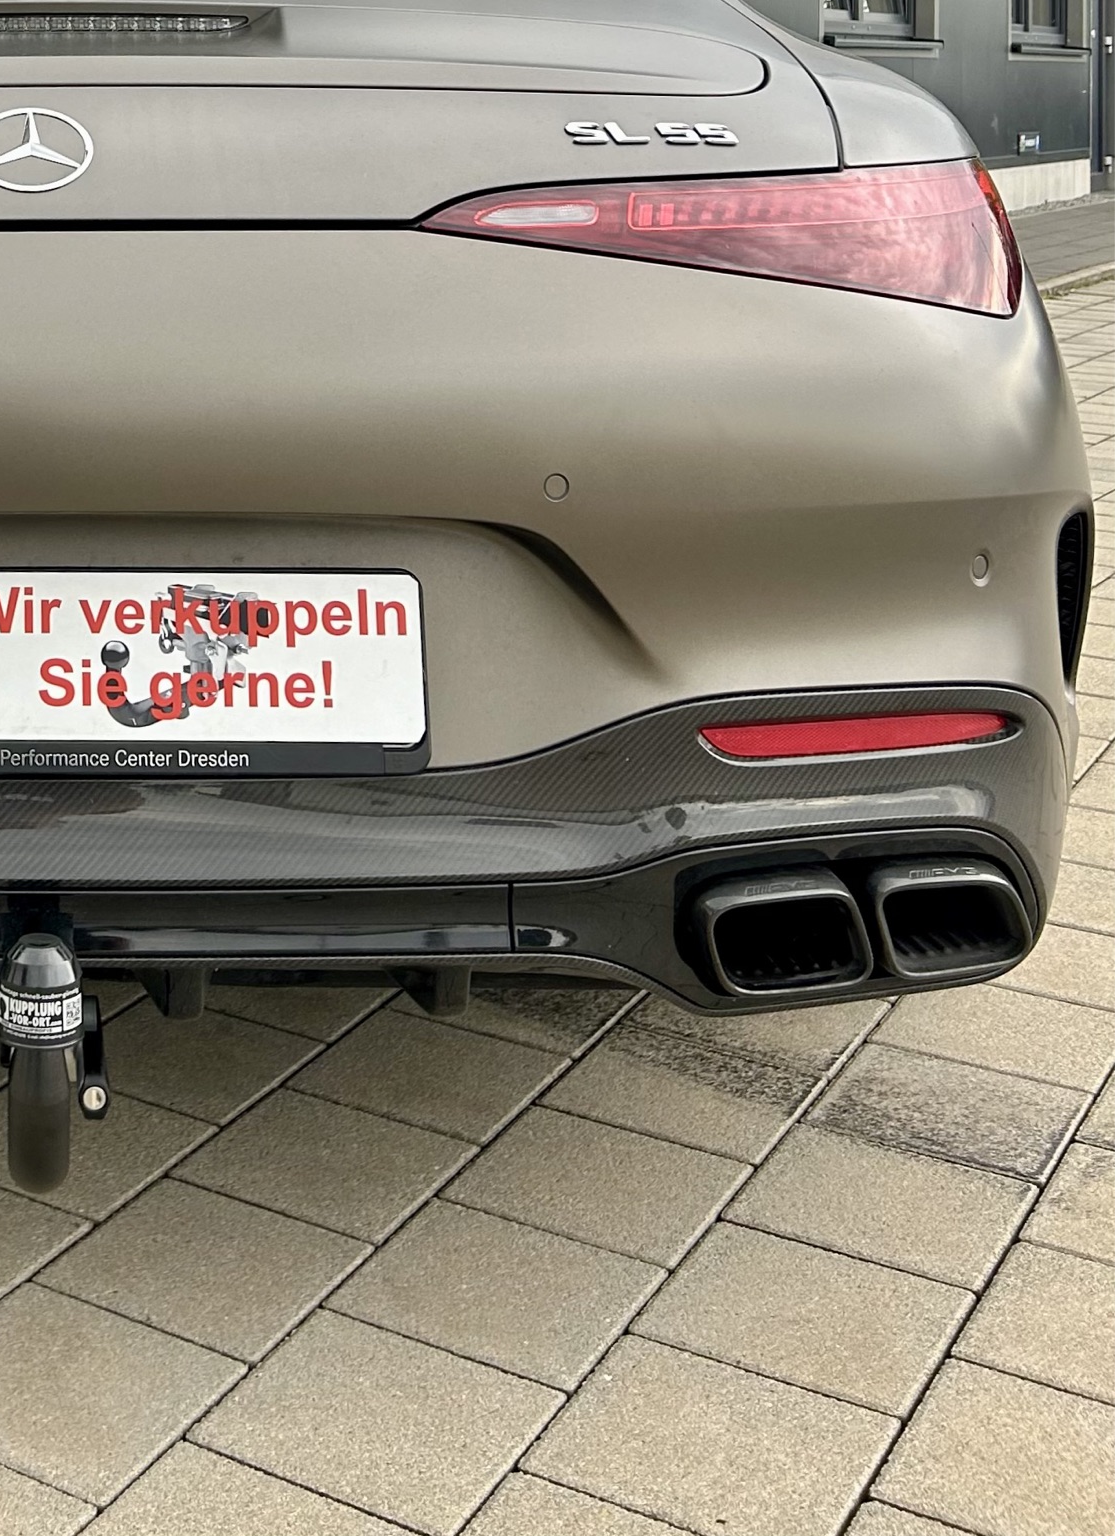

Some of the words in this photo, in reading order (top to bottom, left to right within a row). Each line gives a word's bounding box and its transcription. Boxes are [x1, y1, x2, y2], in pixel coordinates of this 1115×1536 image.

[564, 121, 651, 145] SL
[79, 588, 407, 647] verkuppeln
[38, 657, 128, 707] Sie
[149, 660, 333, 721] gerne!
[0, 749, 109, 767] Performance
[115, 749, 173, 767] Center
[178, 749, 250, 767] Dresden
[9, 998, 62, 1017] KUPPLUNG
